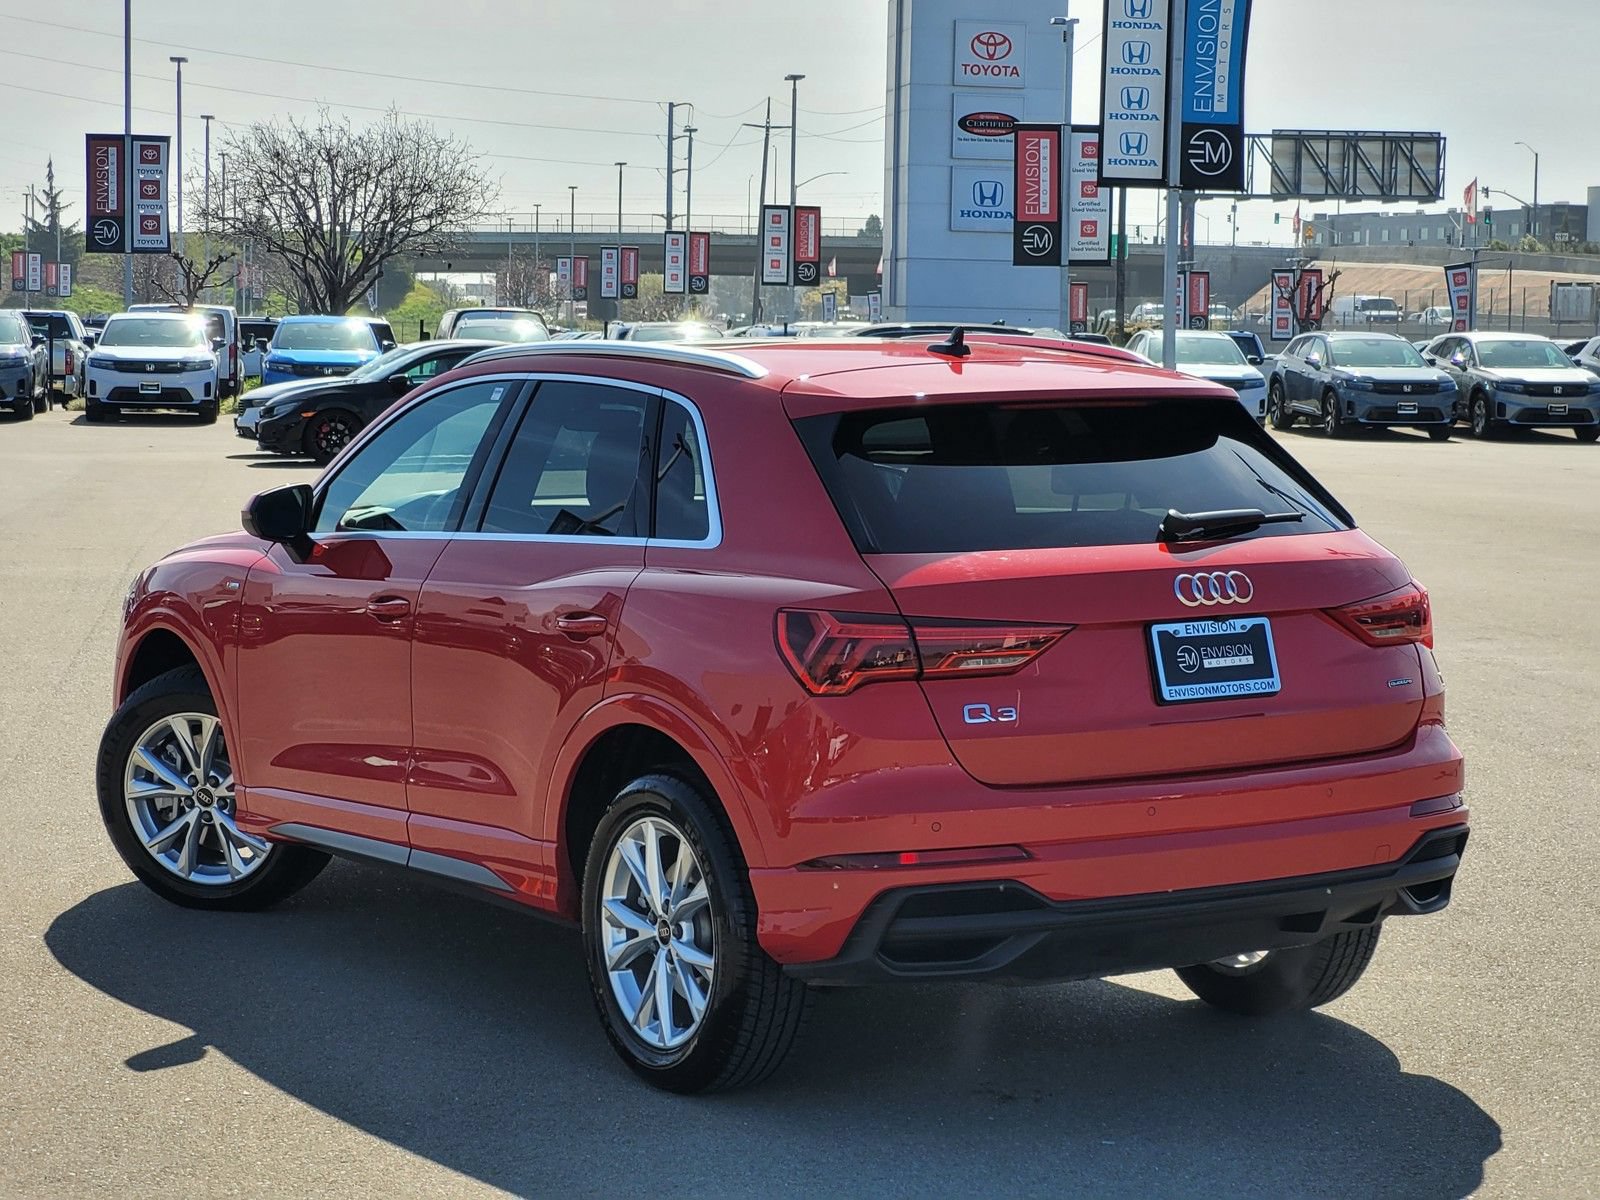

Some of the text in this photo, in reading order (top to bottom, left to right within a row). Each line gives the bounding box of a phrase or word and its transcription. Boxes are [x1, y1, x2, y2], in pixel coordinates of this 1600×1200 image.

[1112, 21, 1163, 30] HONDA
[1193, 0, 1219, 112] ENVISION
[1217, 8, 1232, 103] MOTORS
[961, 63, 1020, 77] TOYOTA
[1110, 67, 1162, 76] HONDA
[966, 119, 1014, 128] CERTIFIED
[1109, 113, 1160, 121] HONDA
[1107, 158, 1158, 167] HONDA
[96, 146, 108, 210] ENVISION
[1025, 137, 1039, 215] ENVISION
[960, 209, 1014, 219] HONDA
[800, 213, 808, 258] ENVISION
[1185, 621, 1236, 635] ENVISION
[1200, 643, 1253, 659] ENVISION
[1207, 657, 1250, 666] MOTORS
[1168, 681, 1277, 698] ENVISIONMOTORS.COM
[963, 703, 1017, 724] Q3
